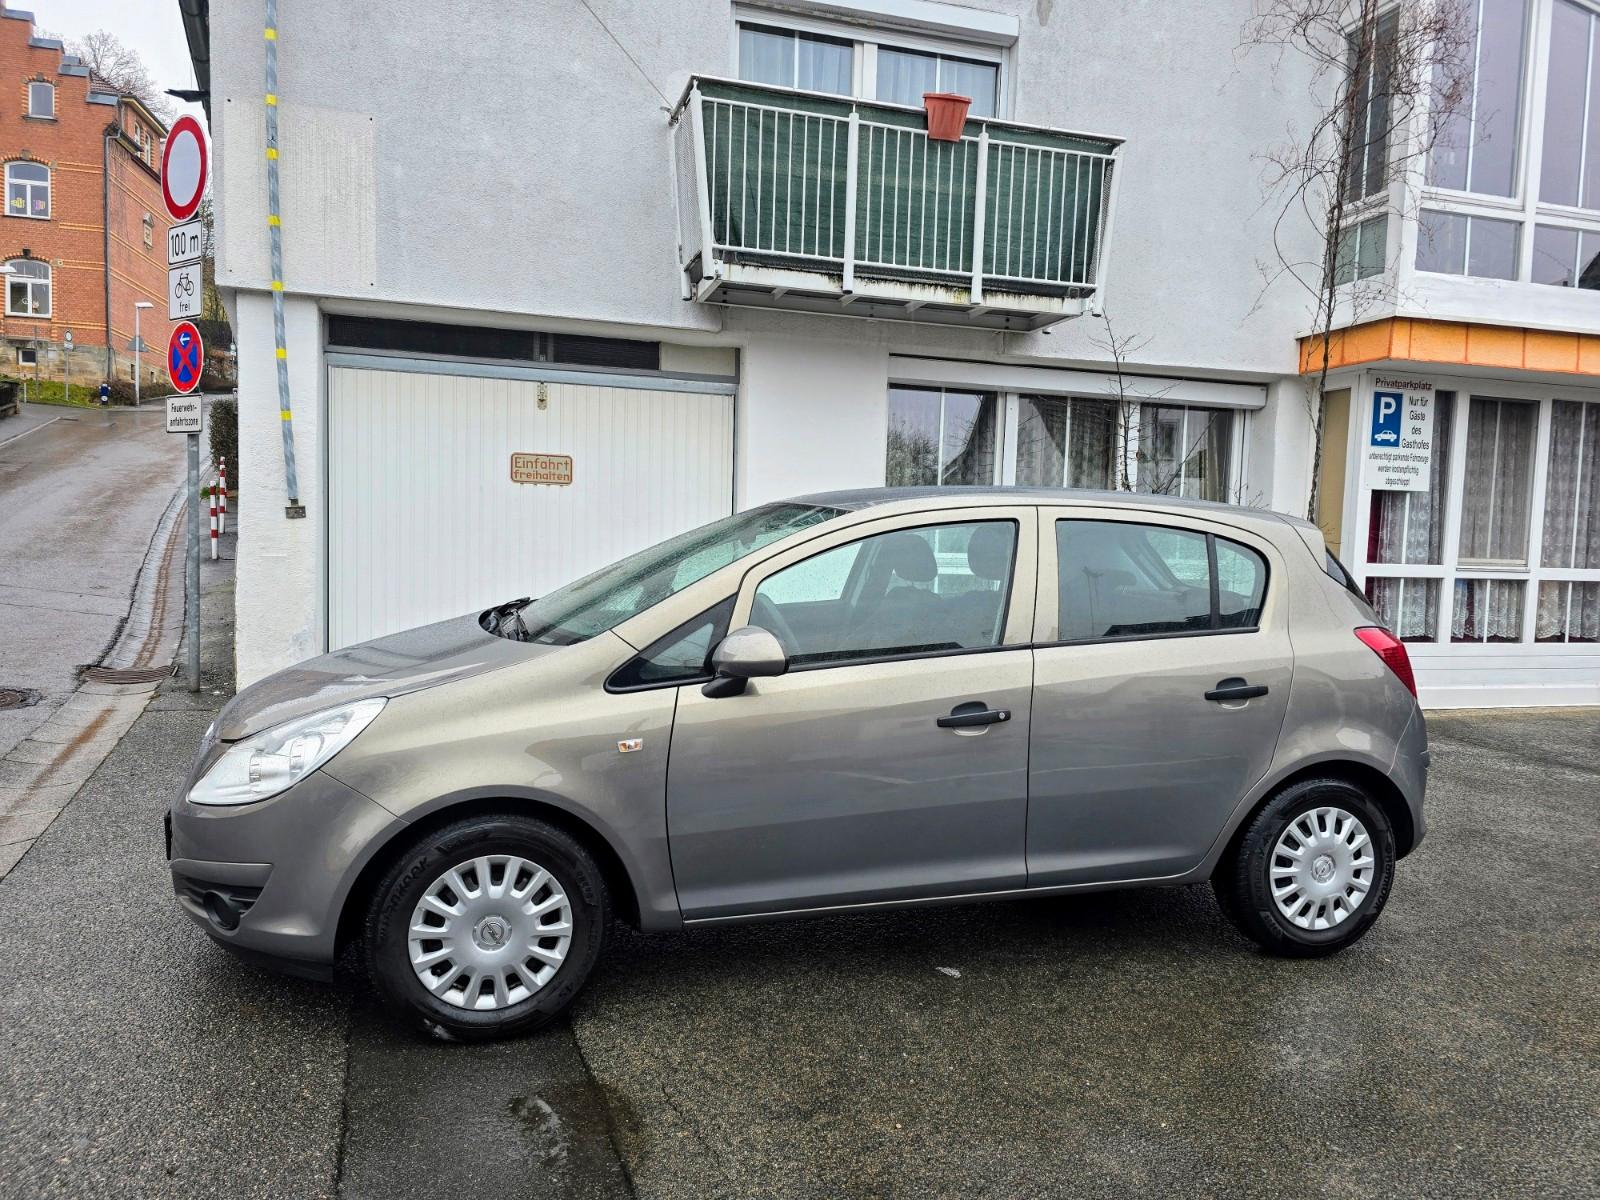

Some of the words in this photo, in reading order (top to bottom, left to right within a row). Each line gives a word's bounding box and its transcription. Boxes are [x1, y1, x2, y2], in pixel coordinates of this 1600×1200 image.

[170, 231, 187, 258] 100
[189, 234, 199, 253] m
[179, 301, 191, 313] frei
[1375, 377, 1432, 391] Privatparkplatz
[1409, 396, 1419, 406] Nur
[1419, 396, 1428, 406] für
[171, 402, 198, 413] Feuerwehr-
[1379, 397, 1396, 423] P
[1409, 410, 1425, 421] Gäste
[170, 416, 199, 427] anfahrtszone
[1411, 425, 1421, 435] des
[1401, 438, 1430, 450] Gasthofes
[514, 456, 569, 471] Einfahrt
[513, 469, 570, 480] freihalten
